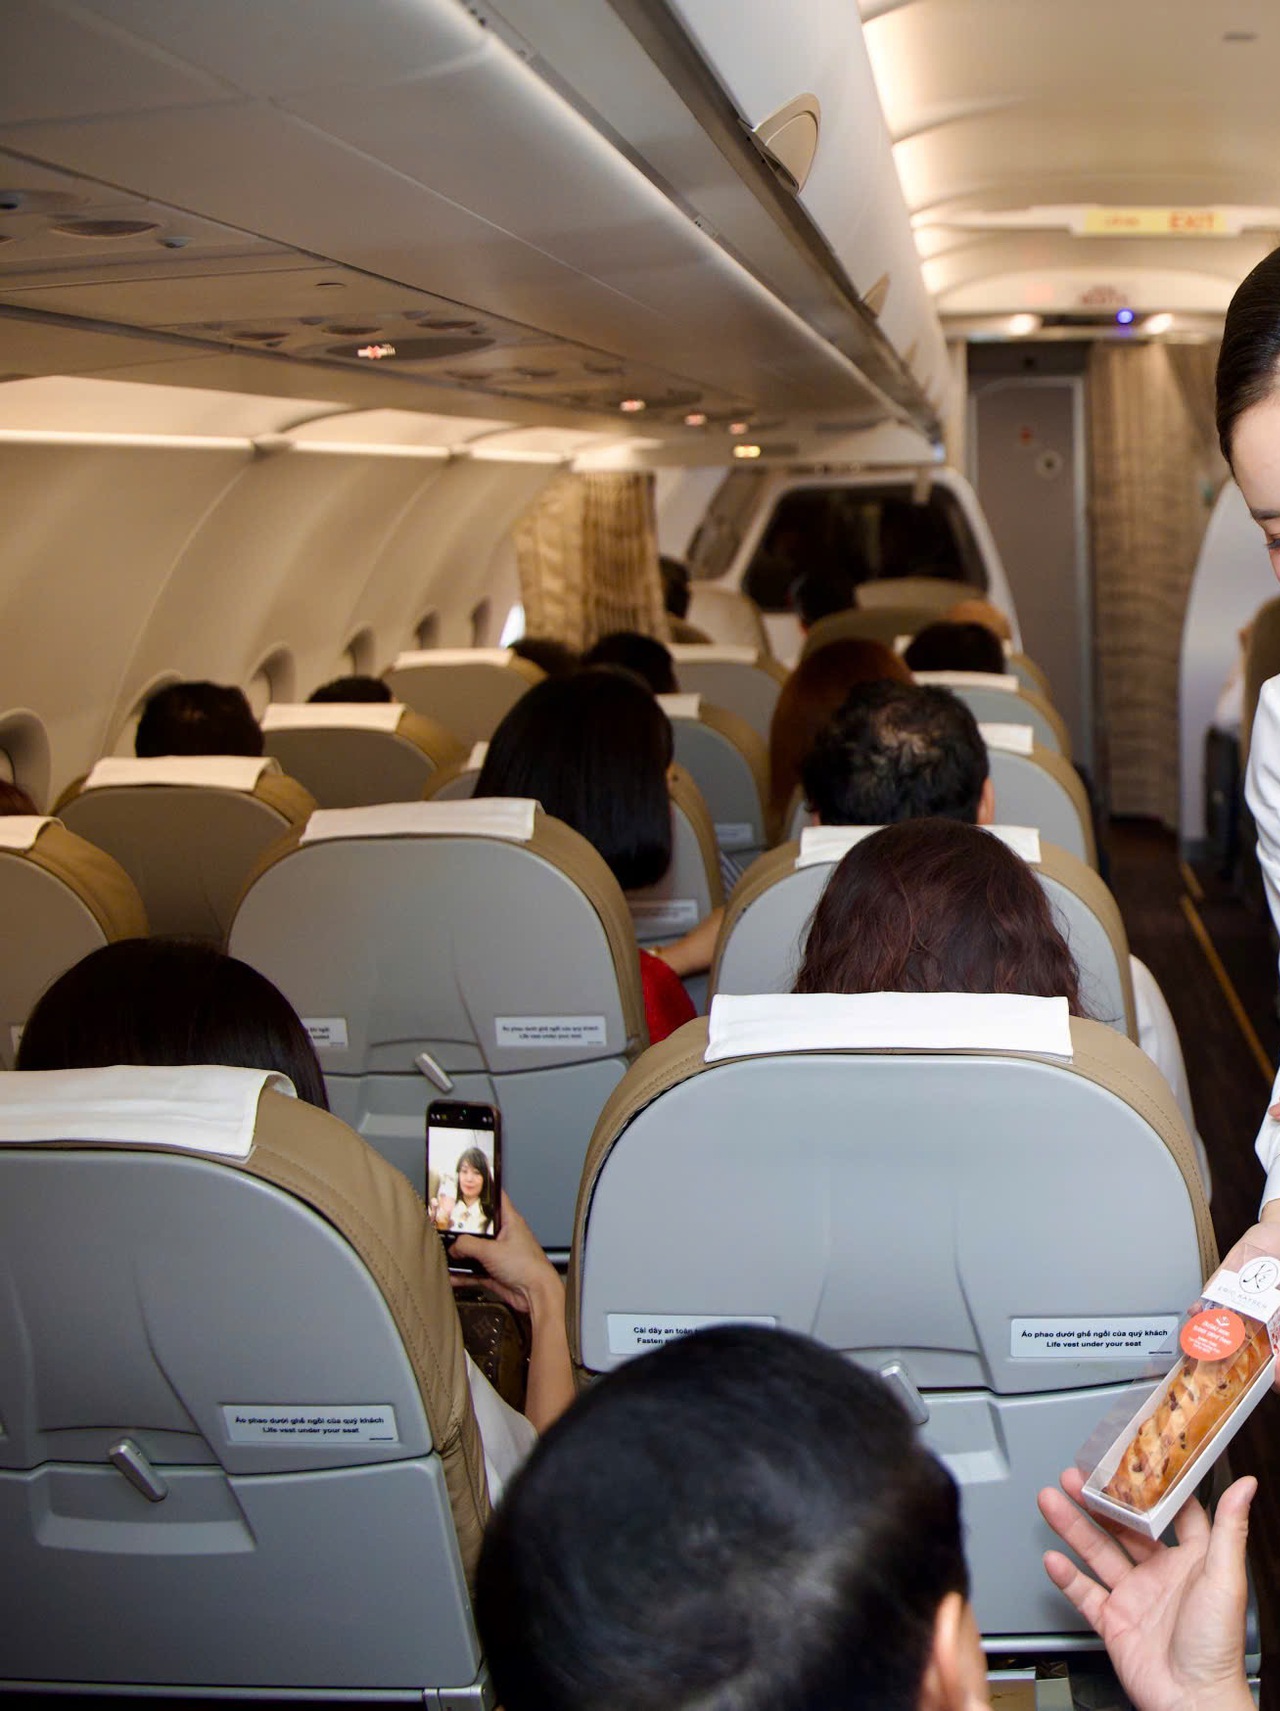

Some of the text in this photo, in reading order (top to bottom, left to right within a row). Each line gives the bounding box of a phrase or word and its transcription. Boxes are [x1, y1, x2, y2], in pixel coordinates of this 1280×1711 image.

[1169, 211, 1215, 230] EXIT
[1021, 1330, 1033, 1338] Áo
[1034, 1331, 1054, 1340] phao
[1056, 1330, 1075, 1338] dưới
[1128, 1330, 1143, 1338] quý
